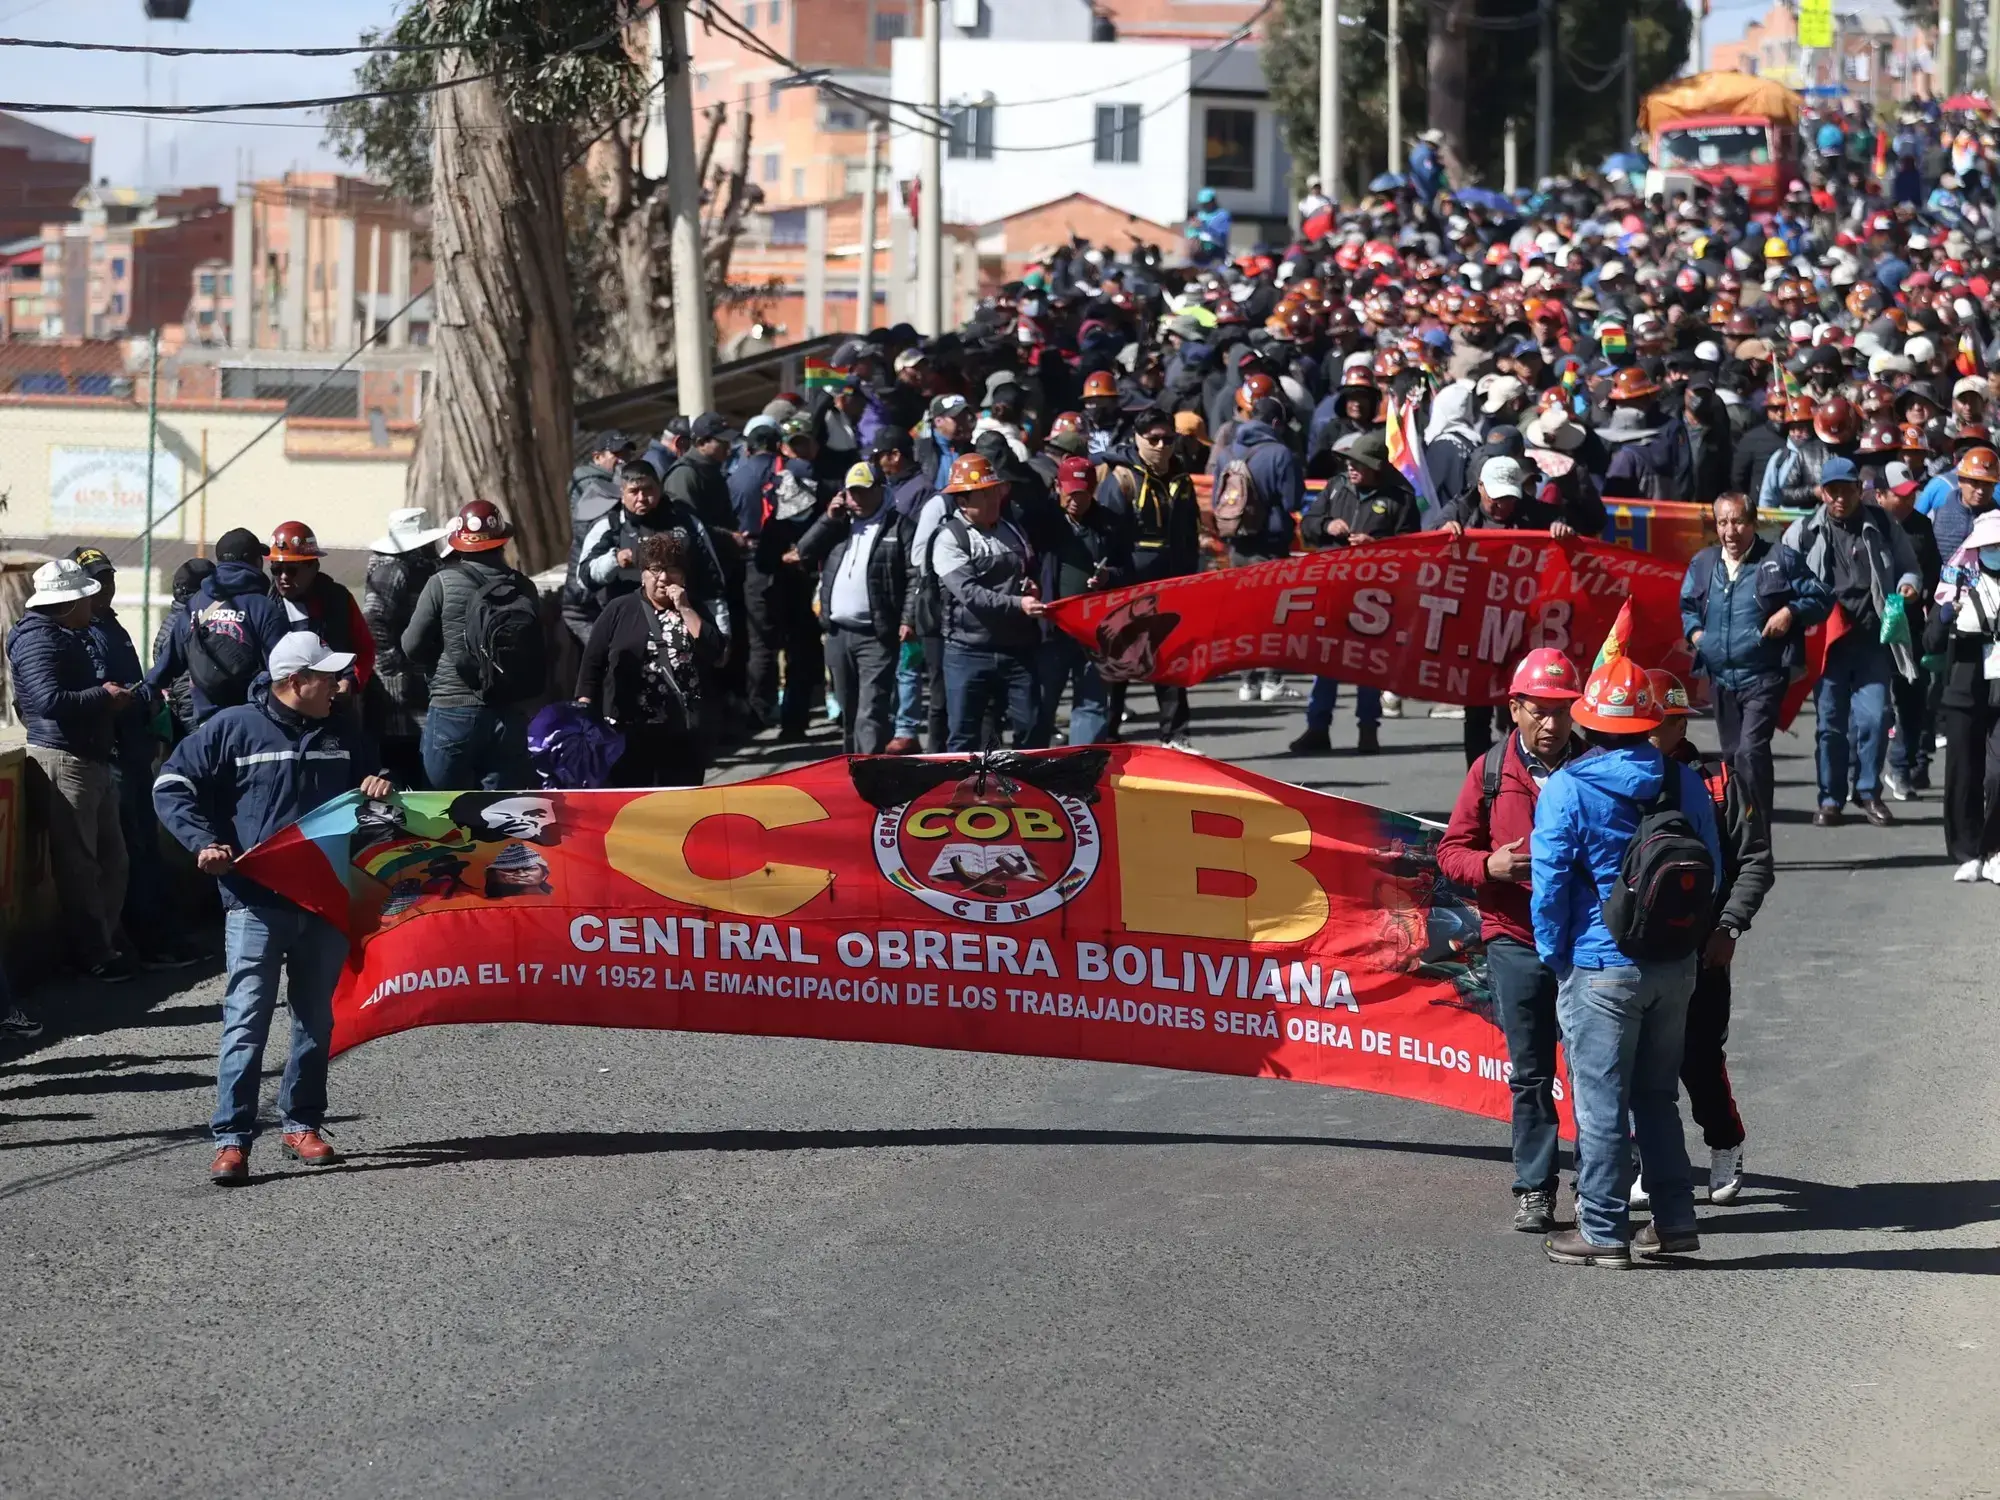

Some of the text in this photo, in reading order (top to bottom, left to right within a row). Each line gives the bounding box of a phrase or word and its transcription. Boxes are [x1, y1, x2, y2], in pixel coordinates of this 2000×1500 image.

[1235, 561, 1631, 604] MINEROS DE BOIVIA
[1164, 632, 1390, 677] PRESENTES
[1419, 660, 1469, 696] EN
[906, 806, 1064, 838] COB
[605, 775, 1330, 942] C B
[952, 900, 1031, 921] CEN
[569, 914, 1359, 1013] CENTRAL OBRERA BOLIVIANA
[478, 963, 509, 984] EL
[516, 963, 544, 984] 17
[596, 965, 656, 989] 1952
[665, 968, 696, 991] LA
[704, 971, 898, 1006] EMANCIPACIÓN
[906, 983, 939, 1006] DE
[948, 984, 997, 1011] LOS
[1005, 988, 1206, 1031] TRABAJADORES
[1214, 1010, 1280, 1039] SERÁ
[1286, 1017, 1354, 1050] OBRA
[1361, 1029, 1392, 1055] DE
[1399, 1035, 1471, 1074] ELLOS
[1478, 1054, 1564, 1101] MISS
